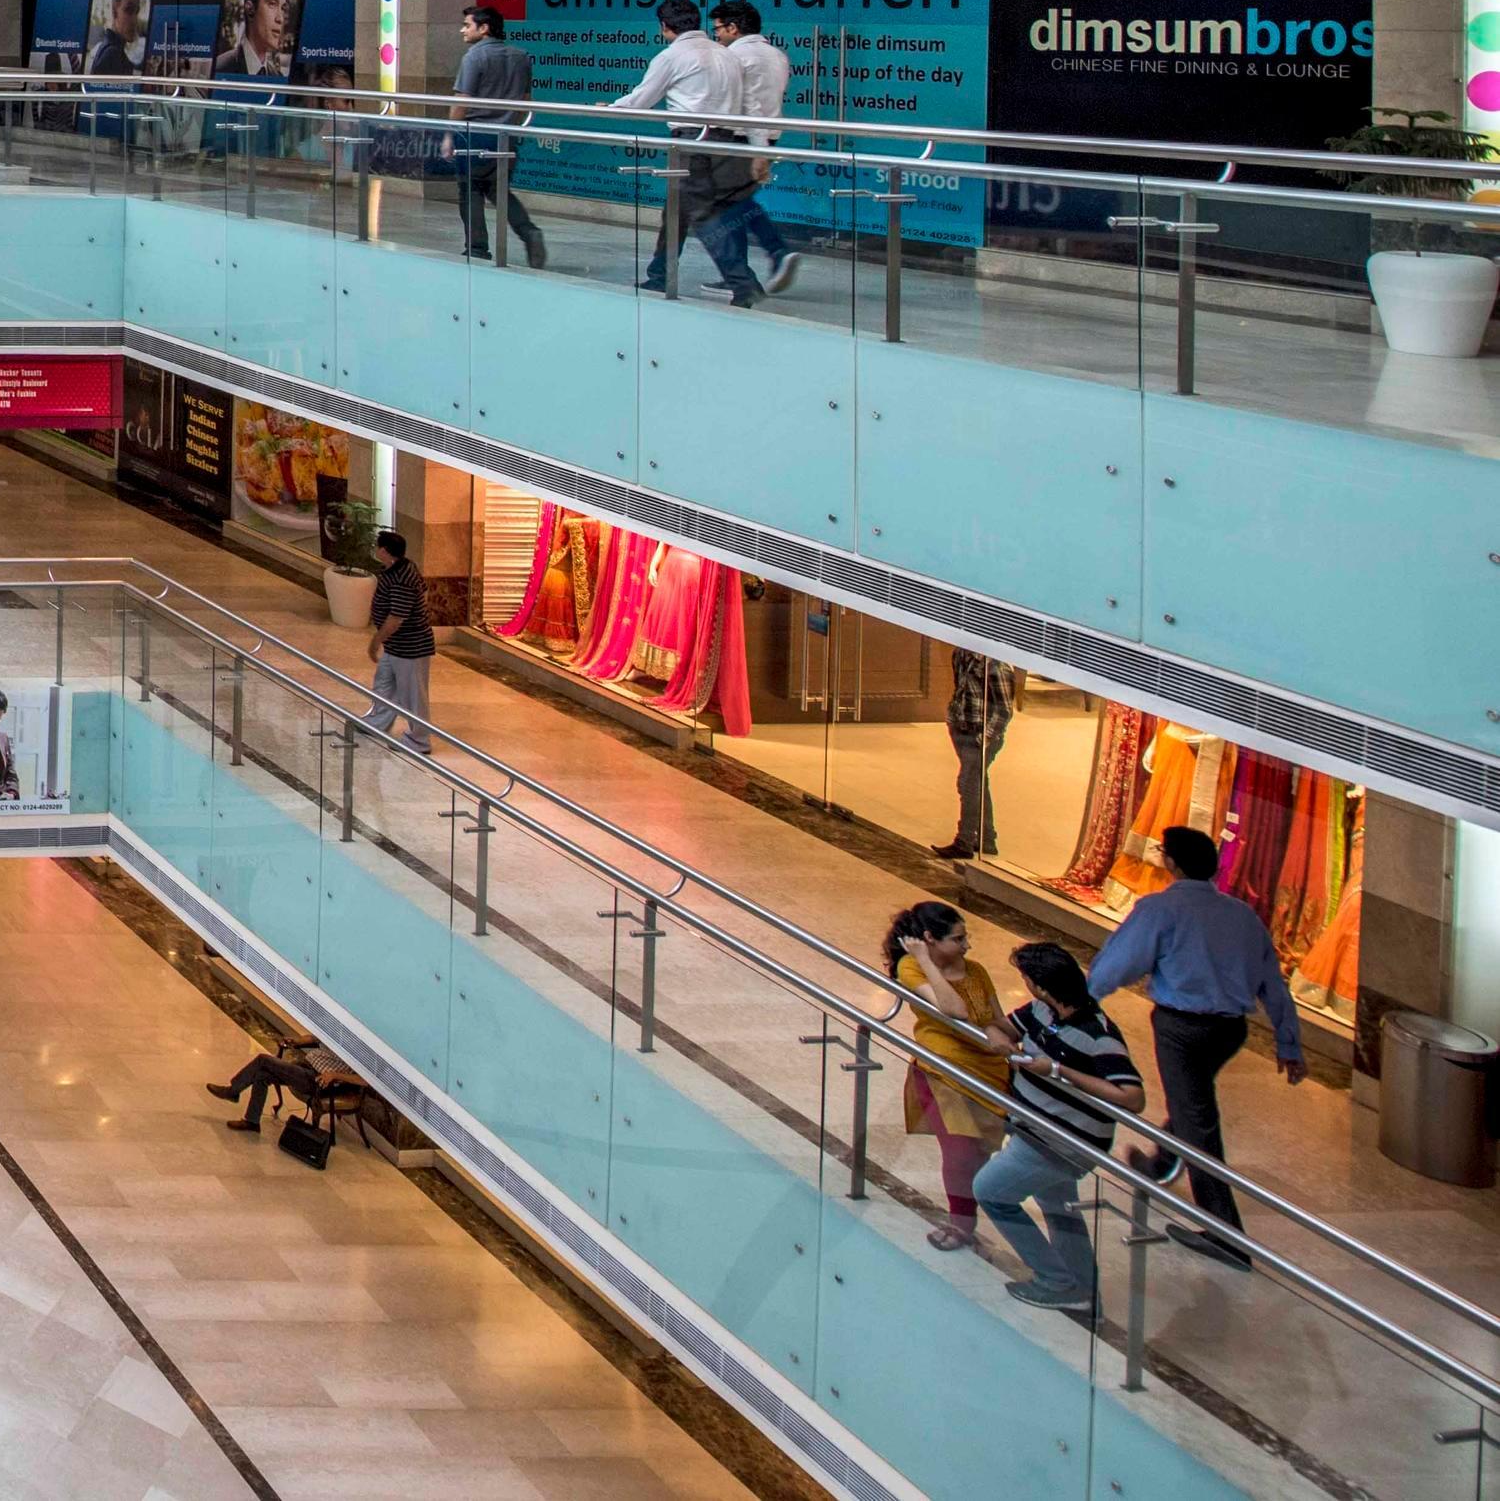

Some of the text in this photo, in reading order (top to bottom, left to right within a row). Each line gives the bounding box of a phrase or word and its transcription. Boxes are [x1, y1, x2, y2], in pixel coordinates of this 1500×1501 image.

[509, 29, 542, 42] select
[544, 32, 577, 45] range
[580, 30, 593, 43] of
[595, 31, 650, 46] seafood,
[876, 36, 946, 53] dimsum
[1029, 8, 1373, 58] dimsumbros
[153, 42, 171, 52] Audo
[301, 46, 354, 61] Sports Headp
[539, 53, 595, 67] unlimited
[875, 64, 893, 80] of
[897, 66, 926, 82] the
[931, 68, 964, 87] day
[1051, 57, 1351, 80] CHINESE FINE DINING & LOUNGE
[532, 78, 551, 89] owl
[555, 78, 584, 91] meal
[587, 80, 629, 96] ending
[852, 94, 917, 111] washed
[183, 393, 225, 418] WE SERVE
[189, 409, 217, 430] Indian
[186, 424, 219, 446] Chinese
[185, 438, 220, 461] Mughlai
[186, 452, 219, 476] Sizzlers
